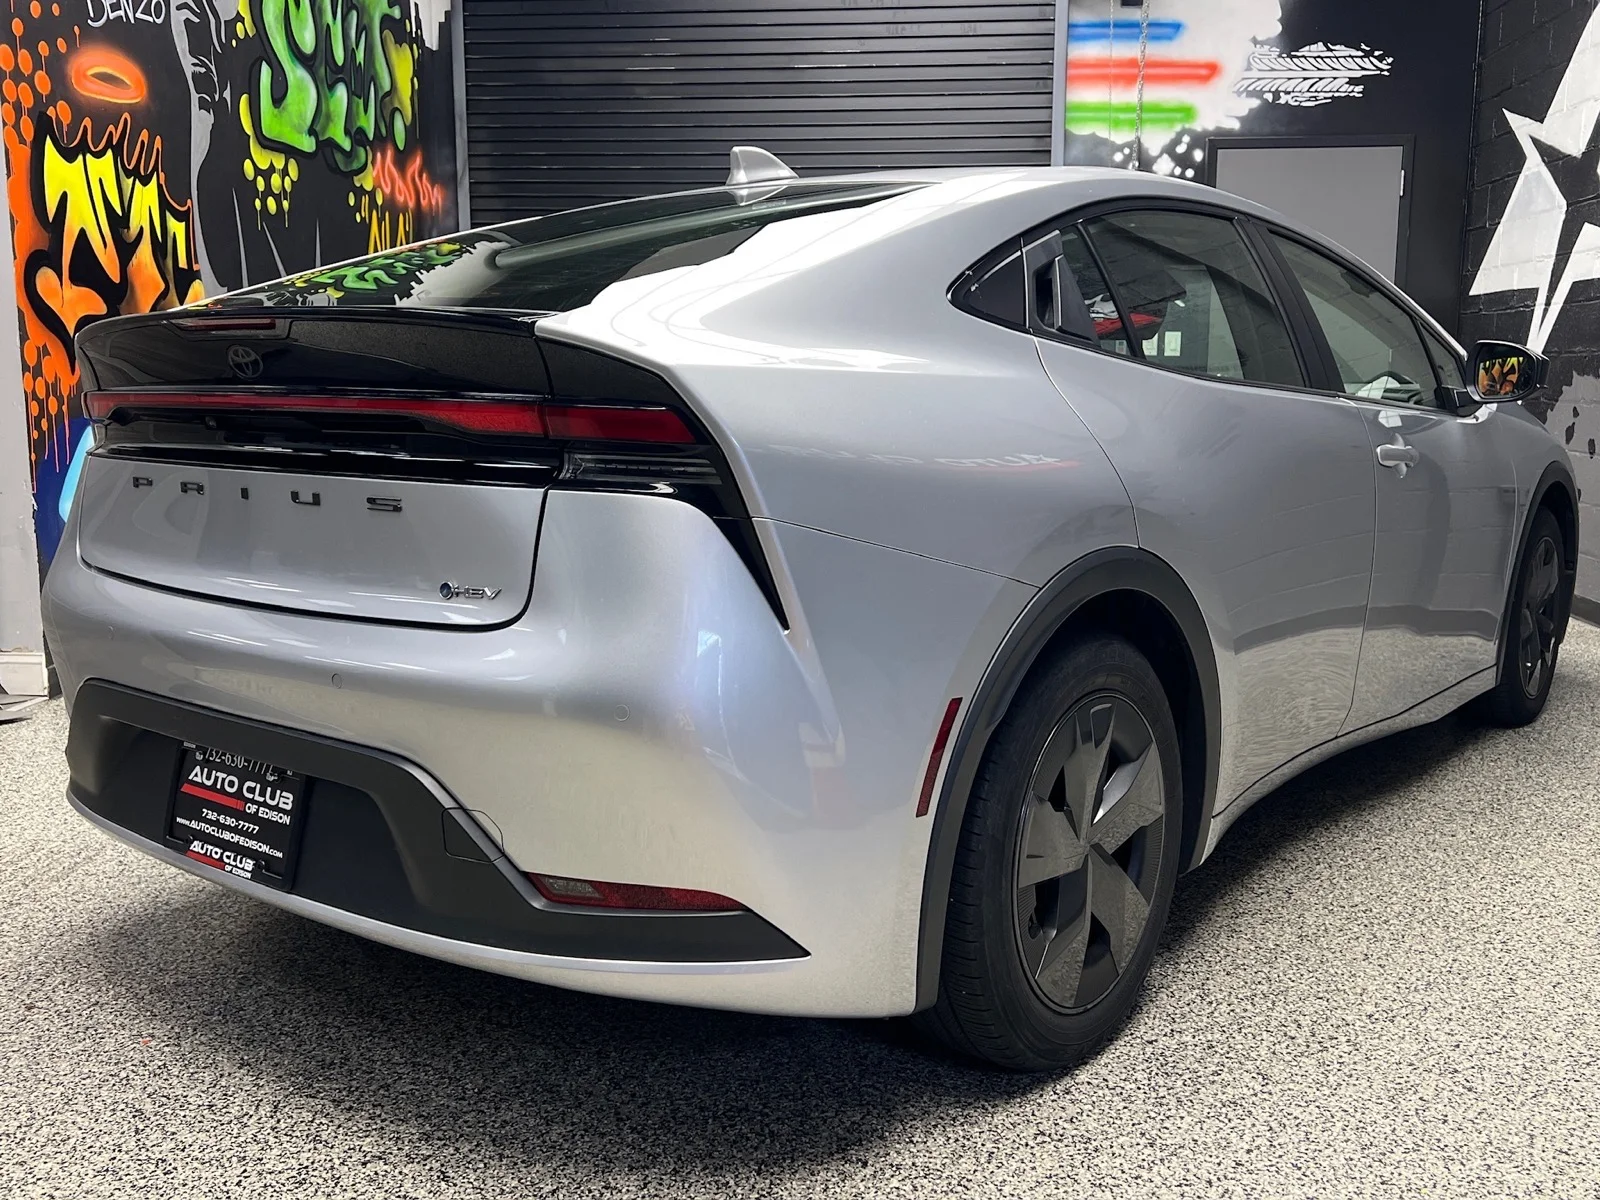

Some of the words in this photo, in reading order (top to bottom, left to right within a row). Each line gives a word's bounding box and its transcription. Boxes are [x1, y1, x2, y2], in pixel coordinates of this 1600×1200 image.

[132, 475, 403, 513] PRIUS
[188, 765, 239, 793] AUTO
[242, 780, 294, 811] CLUB
[201, 808, 260, 834] 732-630-7777
[245, 802, 258, 815] OF
[258, 810, 291, 826] EDISON
[189, 840, 221, 860] AUTO
[222, 851, 255, 872] CLUB
